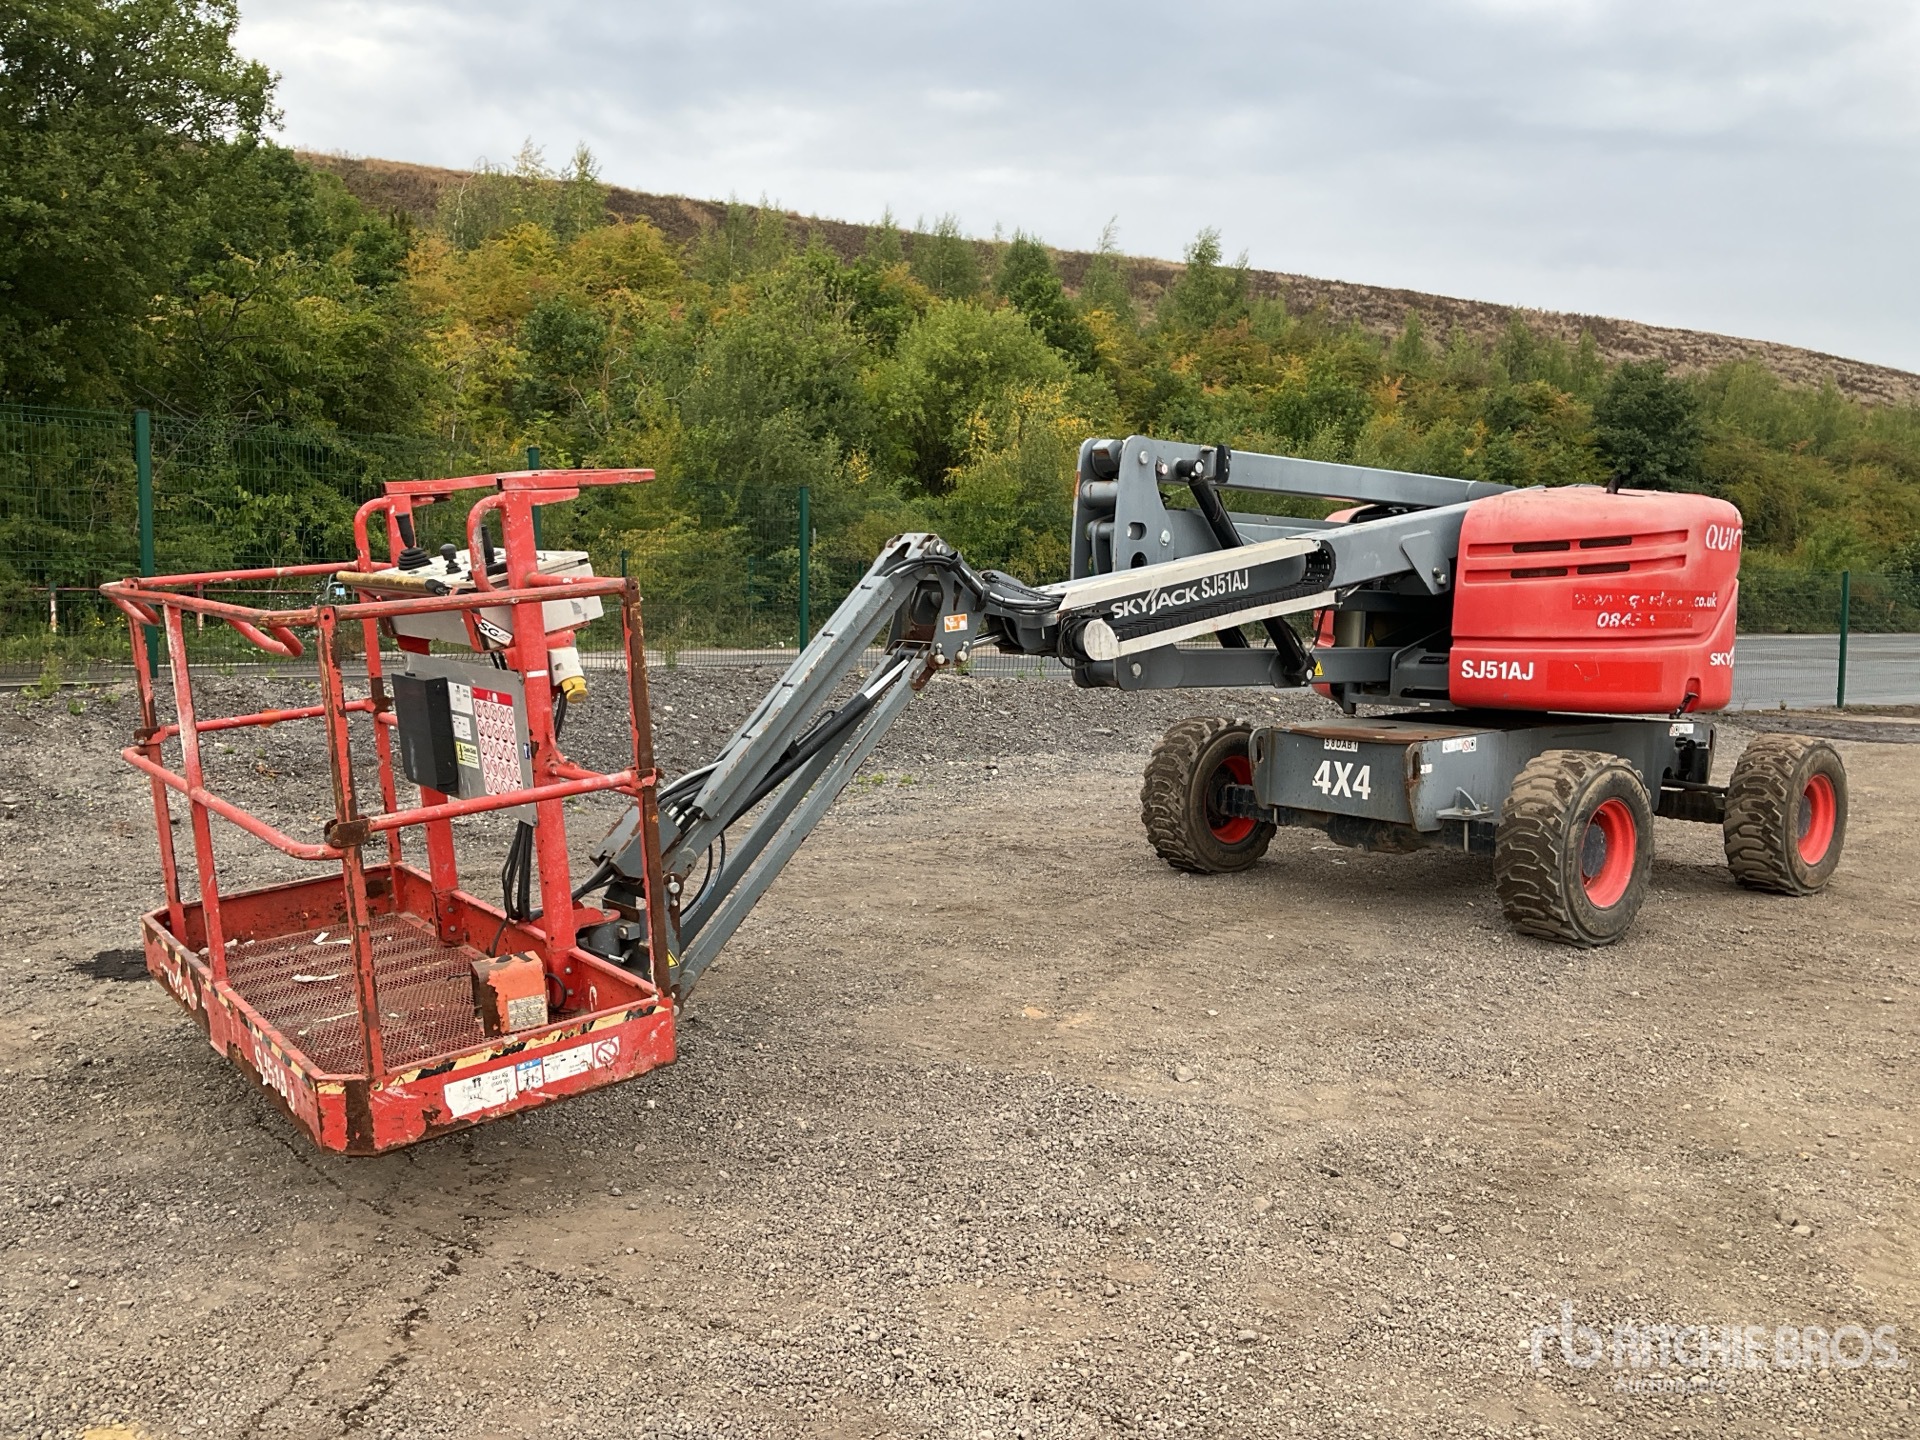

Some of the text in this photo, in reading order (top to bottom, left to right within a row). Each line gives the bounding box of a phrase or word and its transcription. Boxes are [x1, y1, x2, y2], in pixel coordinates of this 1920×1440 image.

[1110, 569, 1249, 619] SKYJACK SJ51AJ
[1461, 660, 1534, 681] SJ51AJ
[1312, 760, 1371, 800] 4X4
